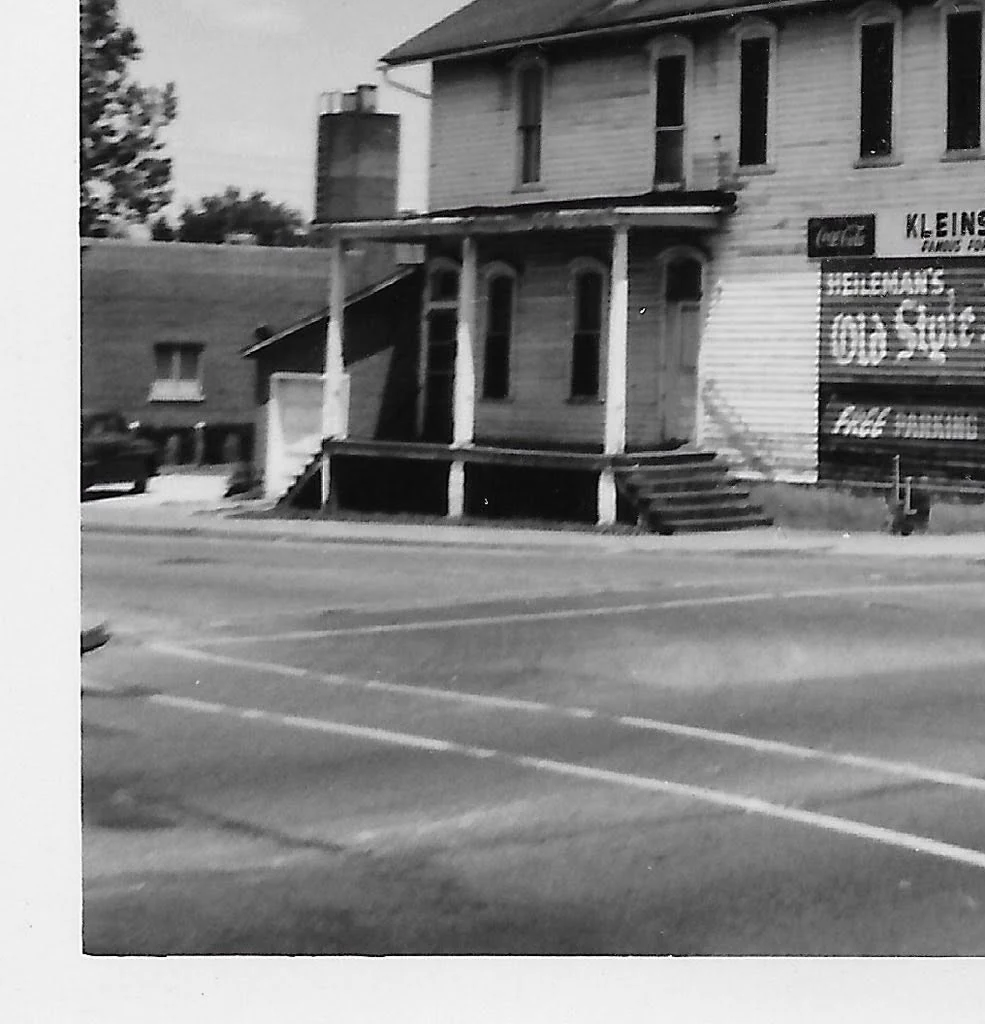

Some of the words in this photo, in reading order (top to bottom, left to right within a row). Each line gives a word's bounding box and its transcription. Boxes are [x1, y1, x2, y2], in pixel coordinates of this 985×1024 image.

[920, 239, 963, 253] FAMOUS
[824, 267, 945, 296] HEILEMAN'S
[830, 312, 888, 366] Old
[894, 287, 976, 366] Style
[894, 412, 978, 440] PARKING
